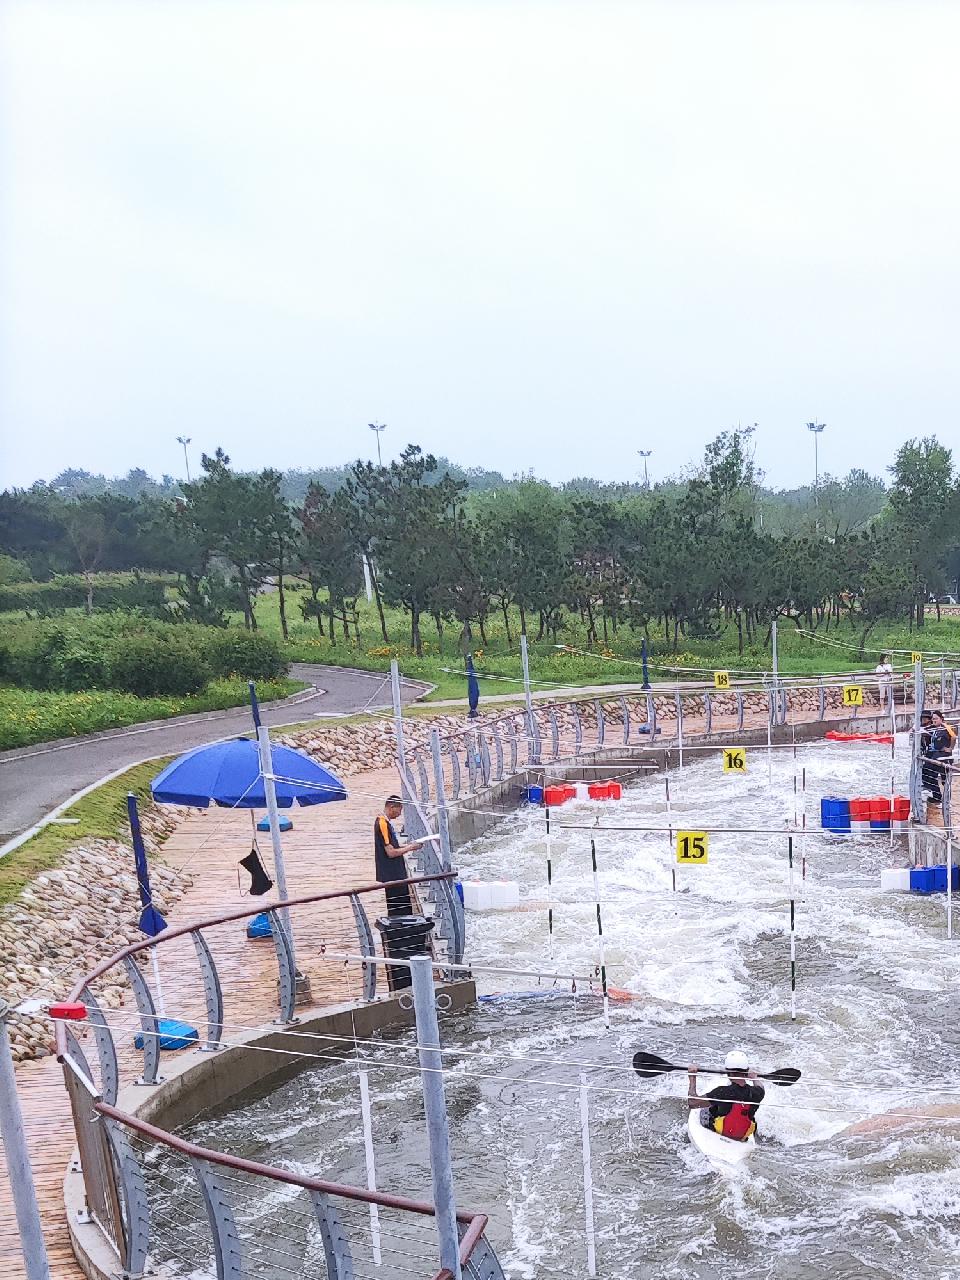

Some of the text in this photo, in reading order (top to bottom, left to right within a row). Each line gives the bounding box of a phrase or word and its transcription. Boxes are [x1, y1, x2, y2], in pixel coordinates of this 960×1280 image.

[717, 674, 728, 686] 18
[846, 689, 859, 701] 17
[726, 752, 744, 769] 16
[680, 836, 705, 859] 15
